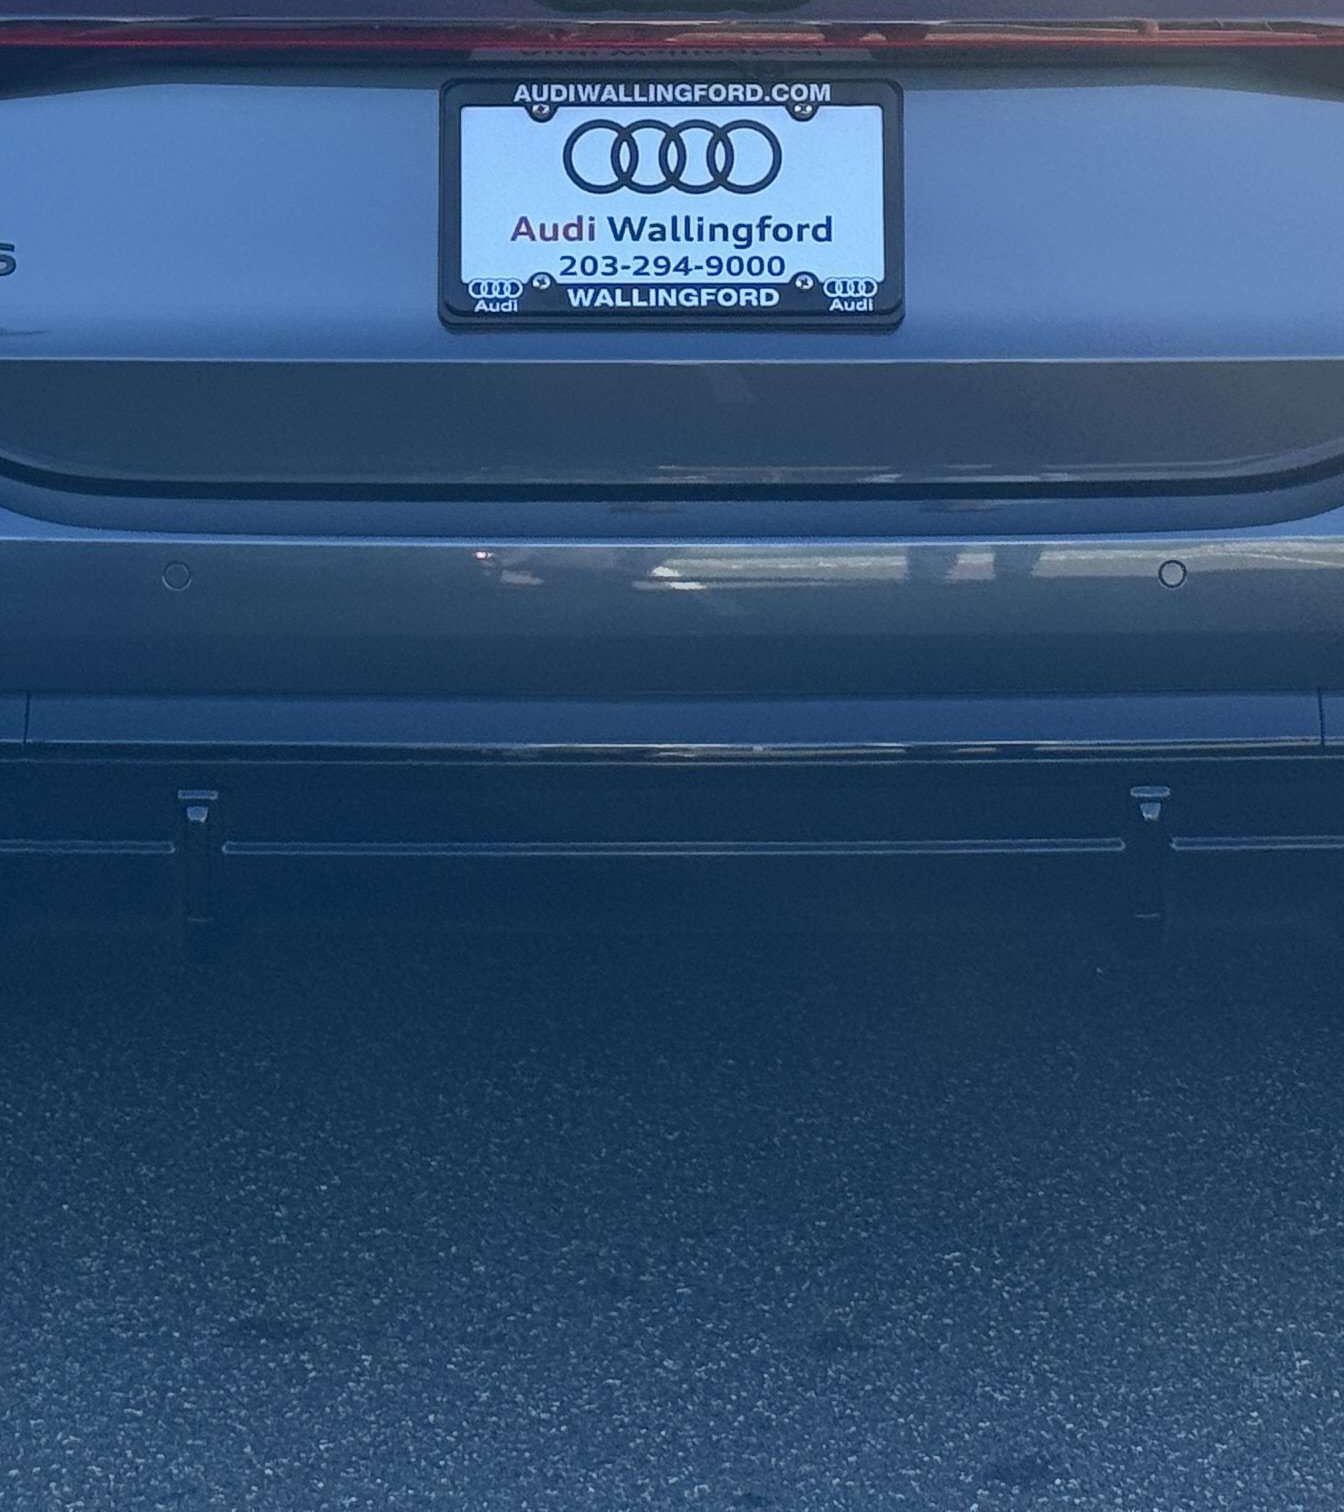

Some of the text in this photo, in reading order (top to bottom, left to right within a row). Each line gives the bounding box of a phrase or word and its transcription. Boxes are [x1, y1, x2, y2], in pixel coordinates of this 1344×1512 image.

[513, 83, 832, 103] AUDIWALLINGFORD.COM
[510, 214, 834, 249] Audi Wallingford
[558, 254, 787, 277] 203-294-9000
[474, 296, 519, 313] Audi
[568, 287, 780, 308] WALLINGFORD
[828, 296, 874, 312] Audi
